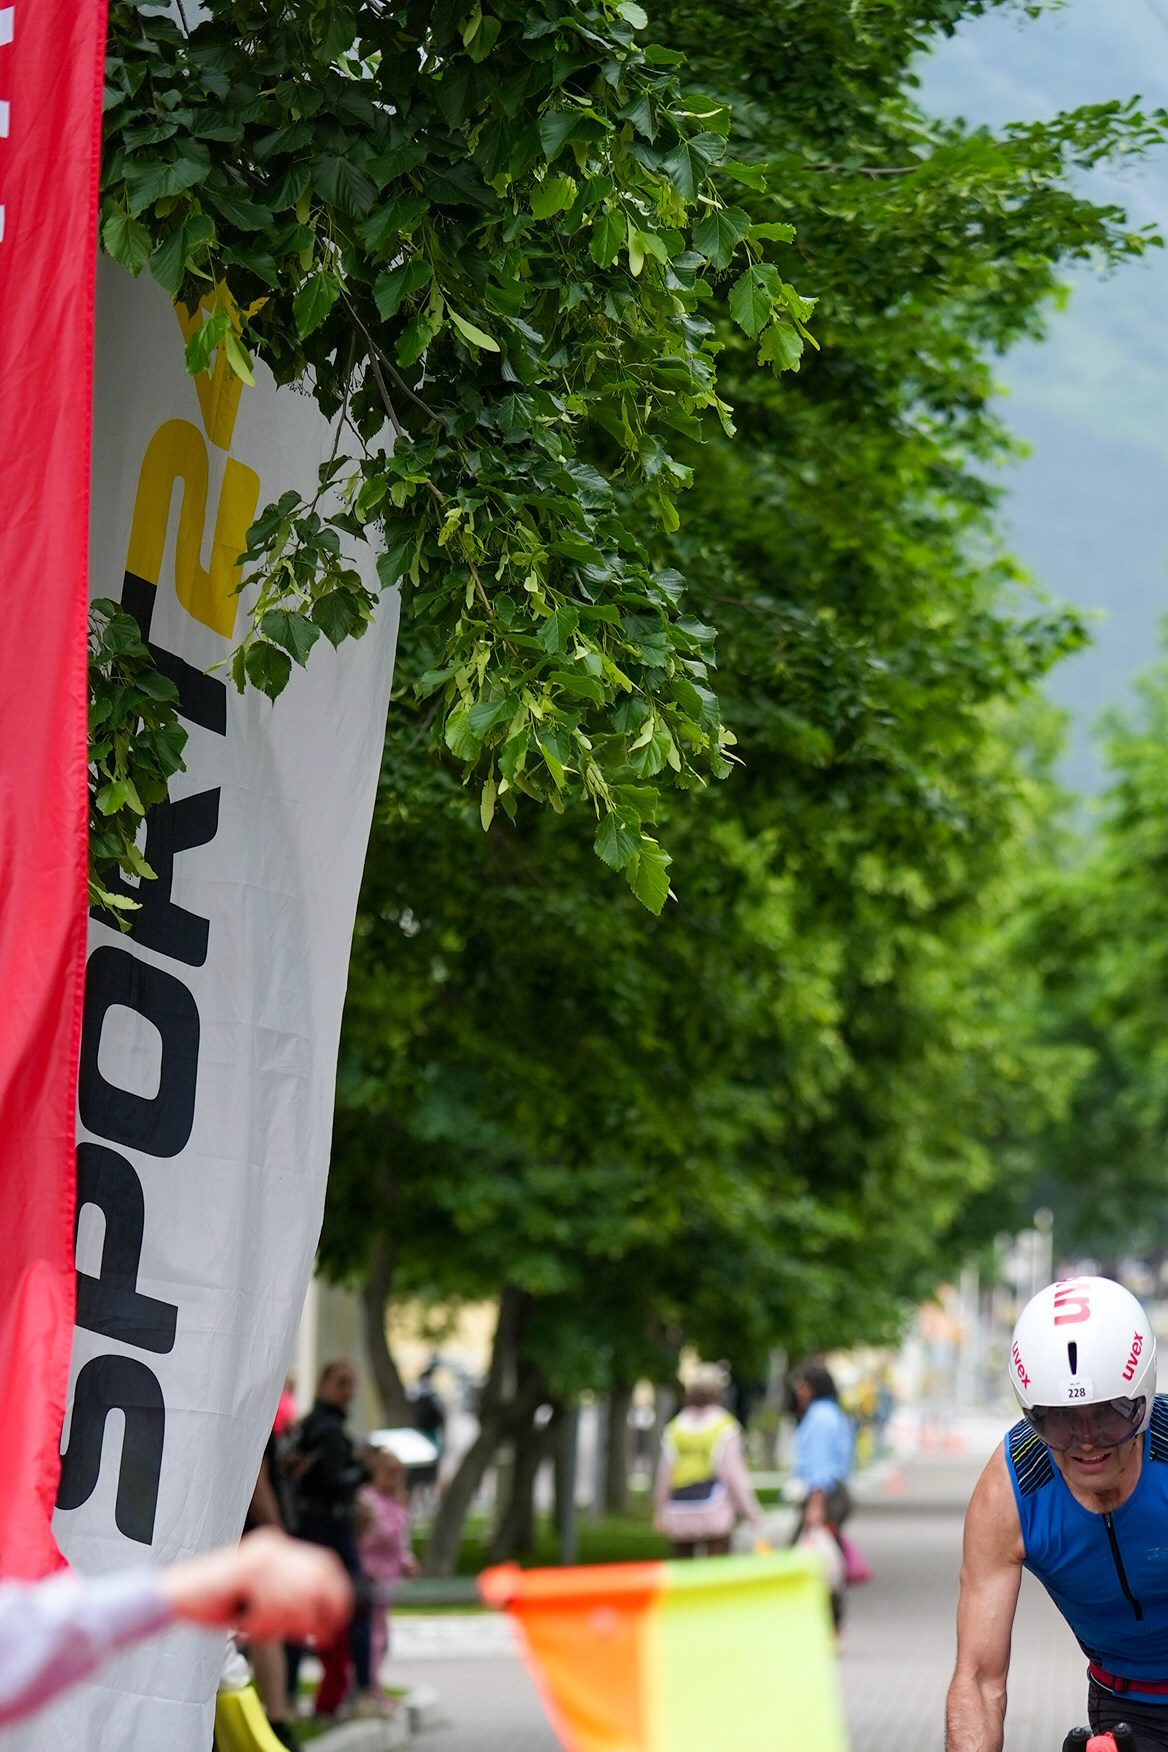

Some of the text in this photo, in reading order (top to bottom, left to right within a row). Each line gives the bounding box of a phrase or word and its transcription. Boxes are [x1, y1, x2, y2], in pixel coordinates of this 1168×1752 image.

[1012, 1340, 1031, 1390] uvex
[1121, 1331, 1143, 1381] uvex
[1068, 1388, 1086, 1399] 228
